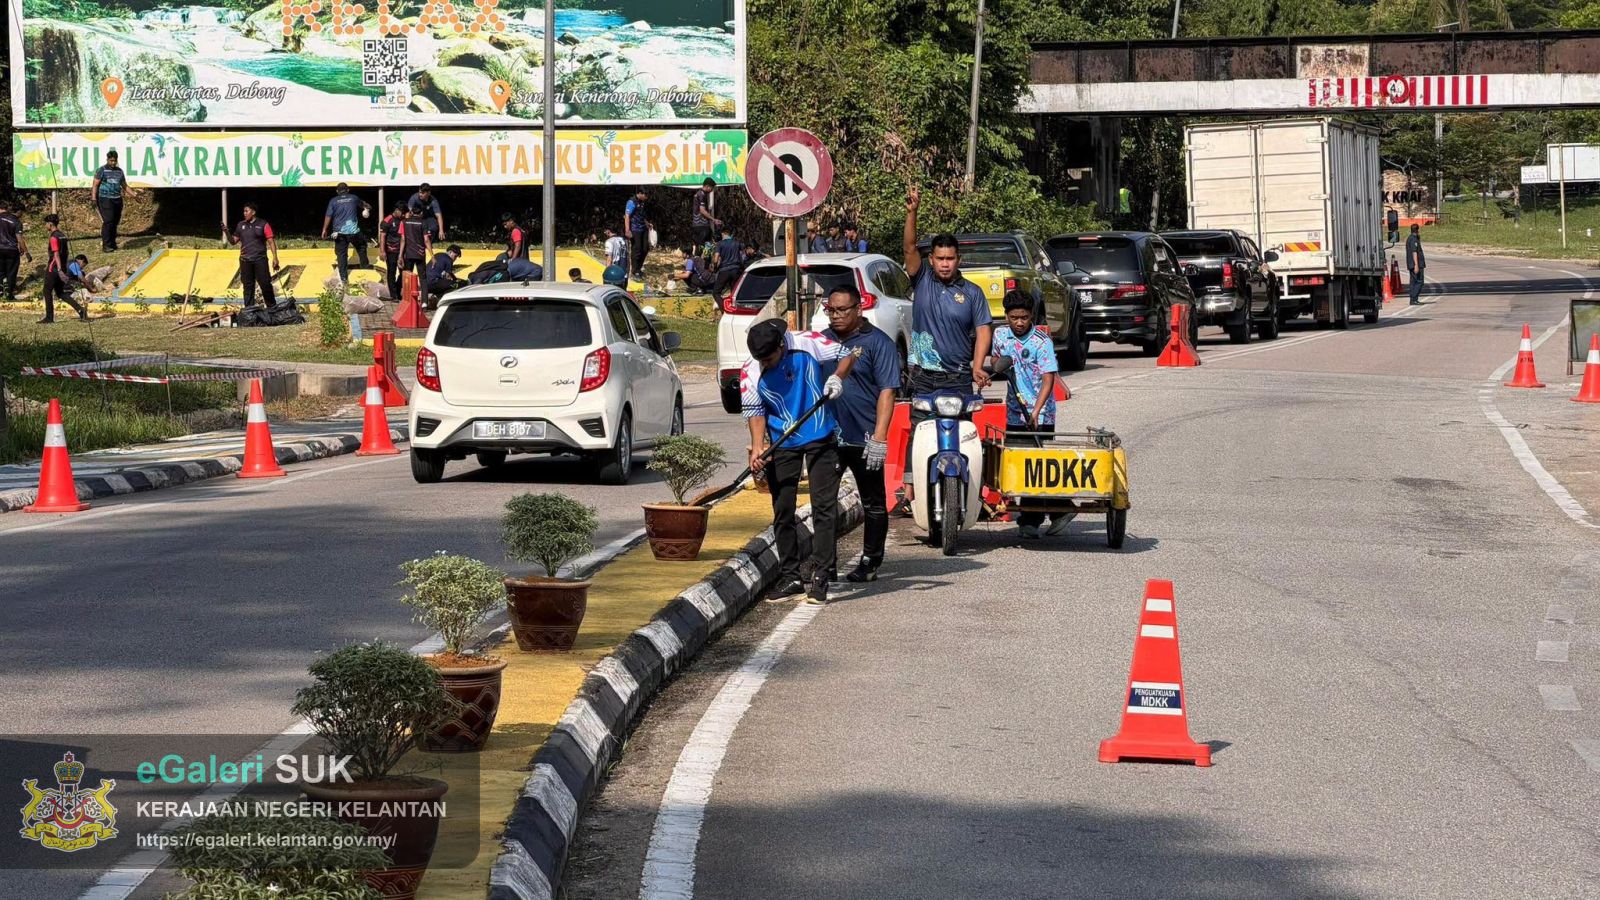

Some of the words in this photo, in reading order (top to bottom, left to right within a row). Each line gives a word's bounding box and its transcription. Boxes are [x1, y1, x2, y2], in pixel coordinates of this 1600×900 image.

[130, 84, 167, 101] Lata
[170, 83, 221, 104] Kertas,
[224, 81, 287, 105] Dabong
[515, 88, 566, 104] Sunai
[569, 87, 640, 106] Kenerong,
[646, 84, 703, 107] Dabong
[47, 146, 158, 176] "KULA
[174, 145, 285, 176] KRAIKU
[301, 144, 398, 180] CERIA,
[609, 143, 727, 174] BERSIH"
[1024, 458, 1098, 489] MDKK
[1135, 689, 1176, 697] PENGUATKUASA
[1141, 696, 1169, 707] MDKK
